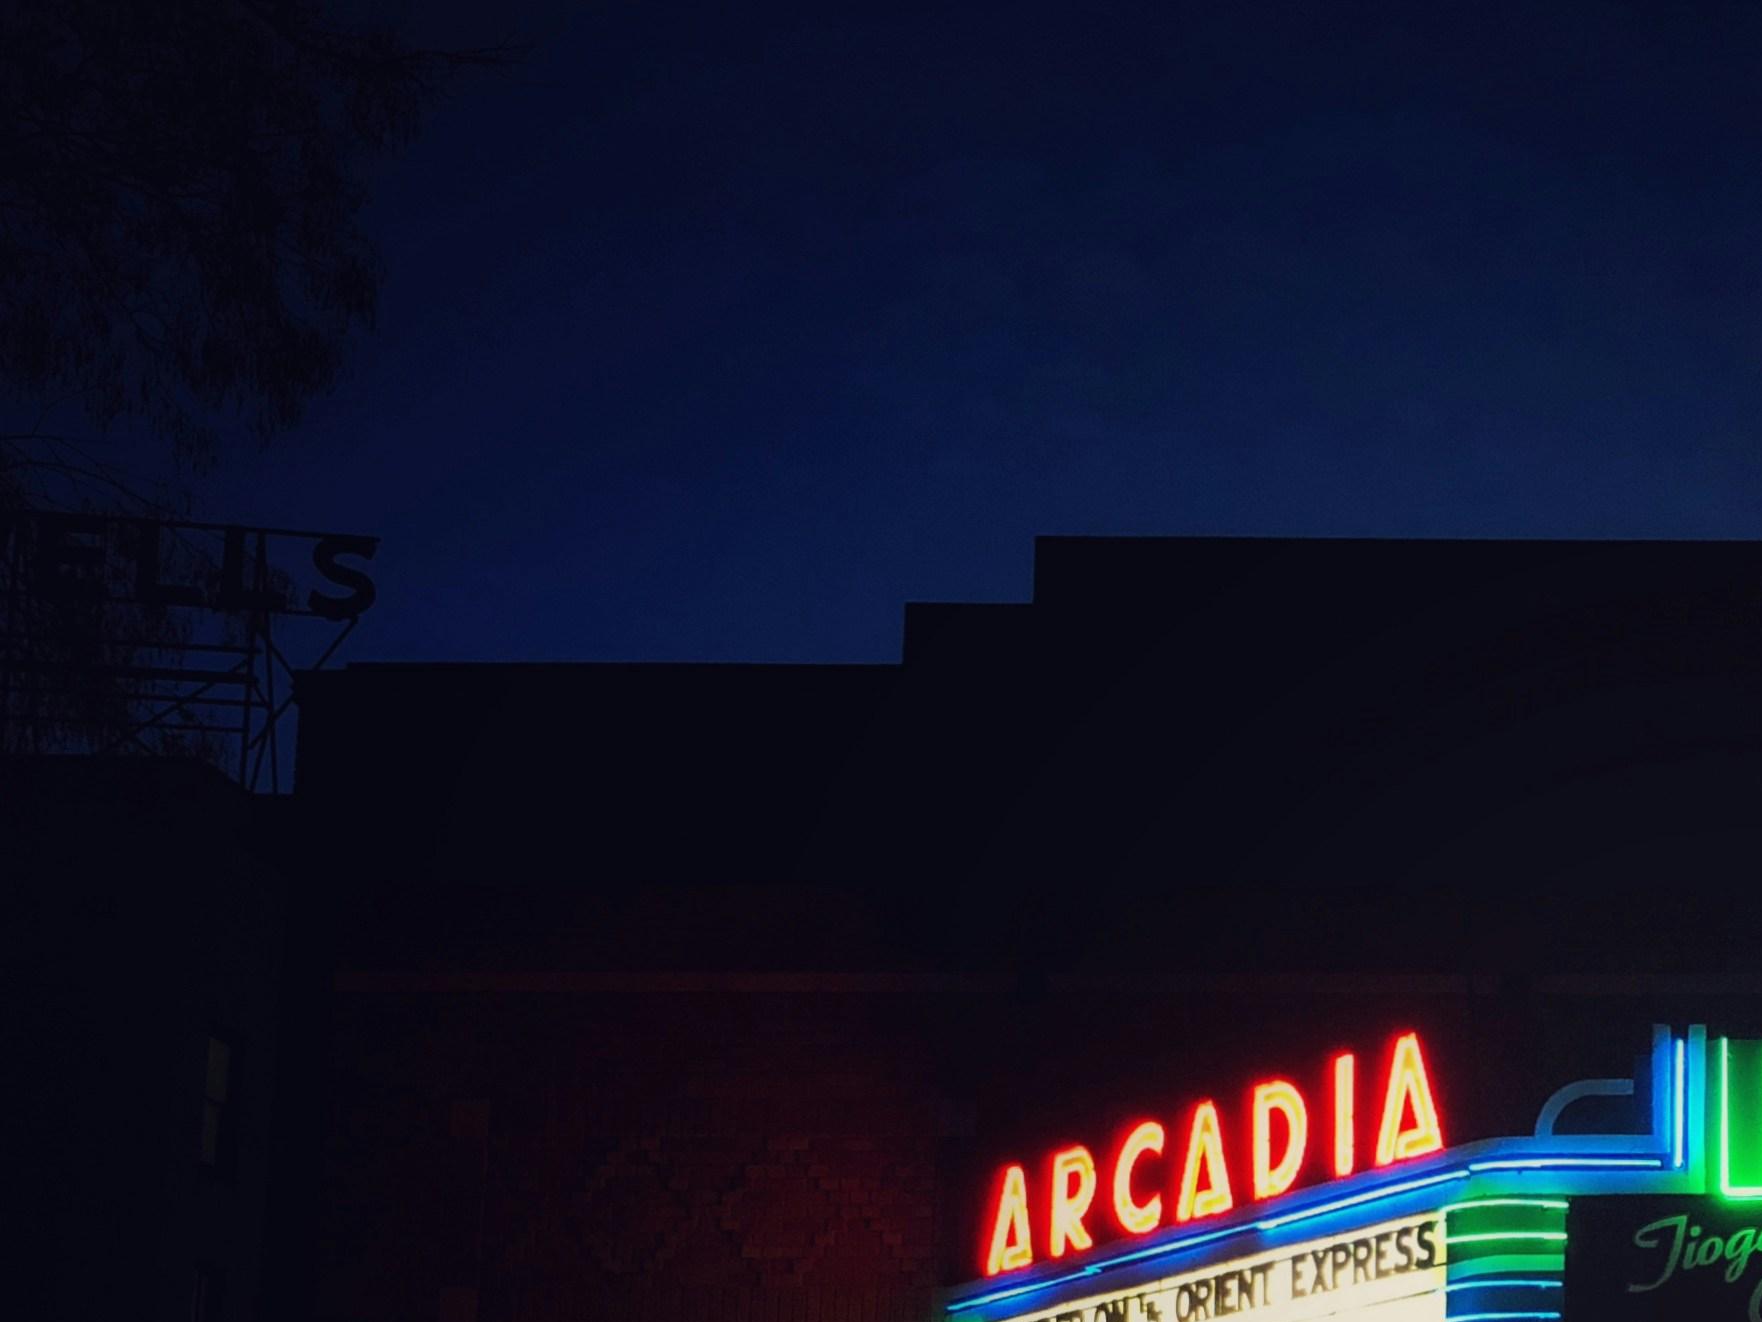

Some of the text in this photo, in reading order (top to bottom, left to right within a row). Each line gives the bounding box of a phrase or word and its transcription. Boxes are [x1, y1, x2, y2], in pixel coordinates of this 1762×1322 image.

[0, 514, 379, 620] ELLS
[985, 1032, 1444, 1277] ARCADIA
[1291, 1220, 1438, 1299] EXPRESS
